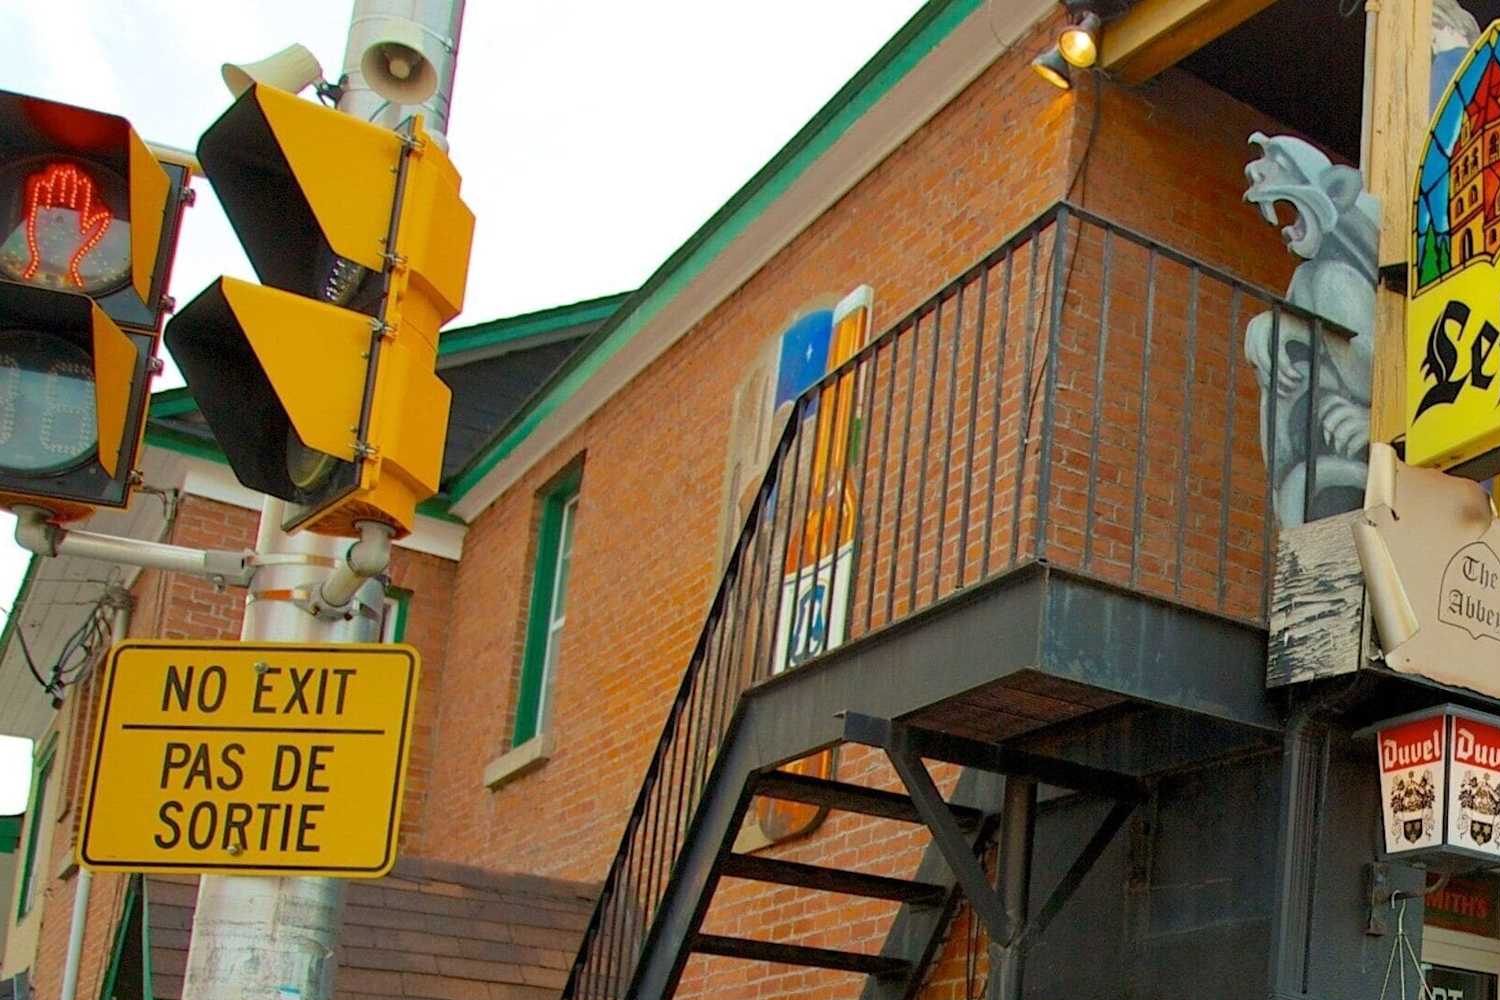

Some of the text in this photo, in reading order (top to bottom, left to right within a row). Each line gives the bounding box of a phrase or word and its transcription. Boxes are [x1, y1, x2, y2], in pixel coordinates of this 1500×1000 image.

[1461, 555, 1499, 591] The
[160, 665, 357, 716] NO EXIT
[160, 742, 334, 793] PAS DE
[1384, 729, 1442, 769] Duvel
[154, 800, 325, 853] SORTIE
